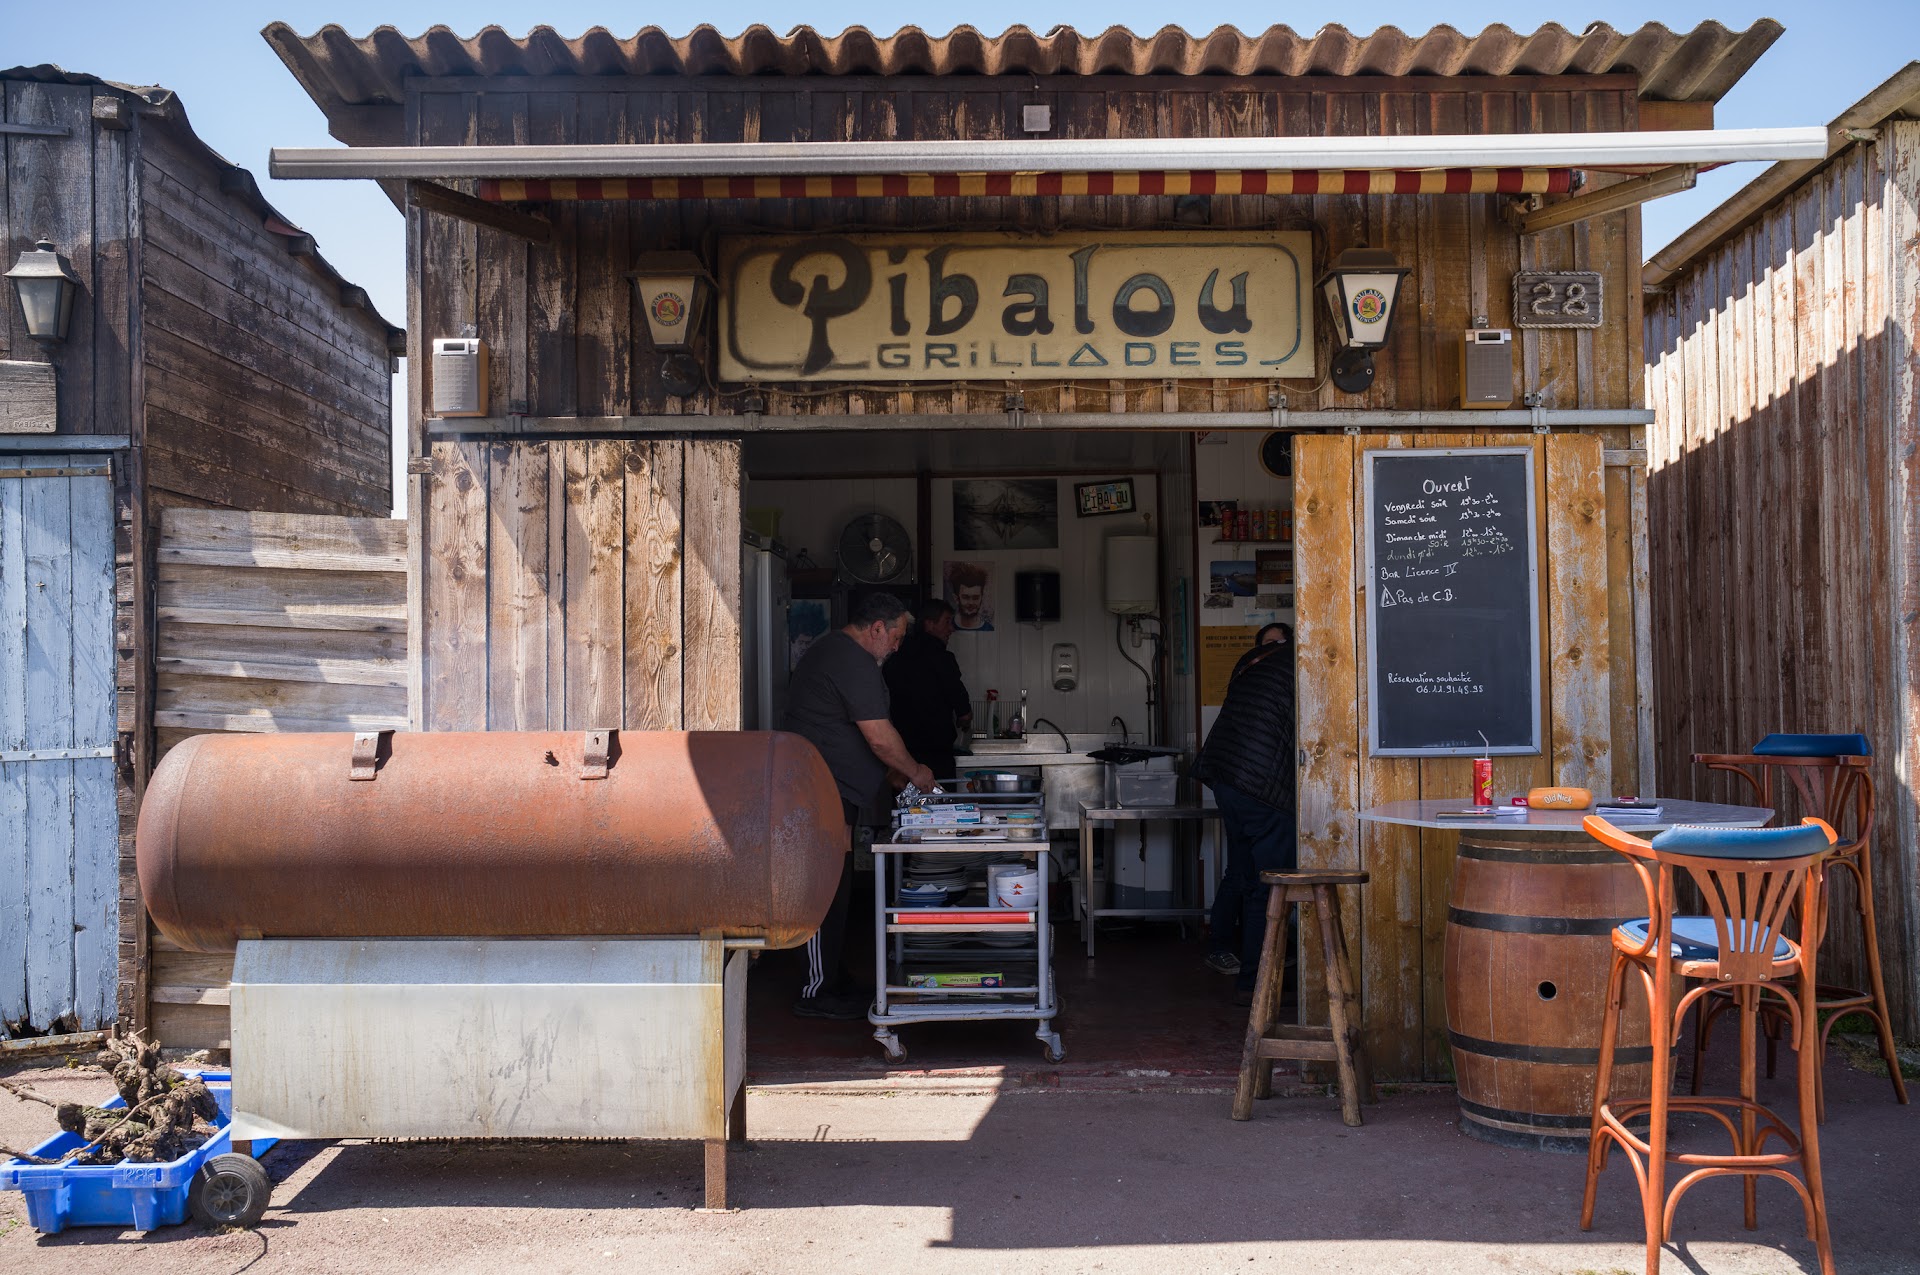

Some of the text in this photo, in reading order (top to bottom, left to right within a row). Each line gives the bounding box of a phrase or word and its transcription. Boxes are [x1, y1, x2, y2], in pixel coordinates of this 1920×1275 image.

[652, 292, 684, 307] PAULANER
[1354, 289, 1385, 304] PAULANER
[1531, 281, 1589, 316] 28
[770, 239, 1254, 375] Pibalou
[1084, 490, 1128, 509] PIBALOU
[1385, 515, 1416, 526] Samedi
[1419, 512, 1437, 523] soir
[1386, 532, 1426, 543] Dimanche
[1429, 529, 1447, 540] midi
[1380, 562, 1459, 580] Bar Licence IV
[1396, 588, 1414, 604] Pas
[1417, 592, 1429, 603] de
[1387, 671, 1472, 683] Réservation souhaitée
[1543, 793, 1573, 805] Old Nick
